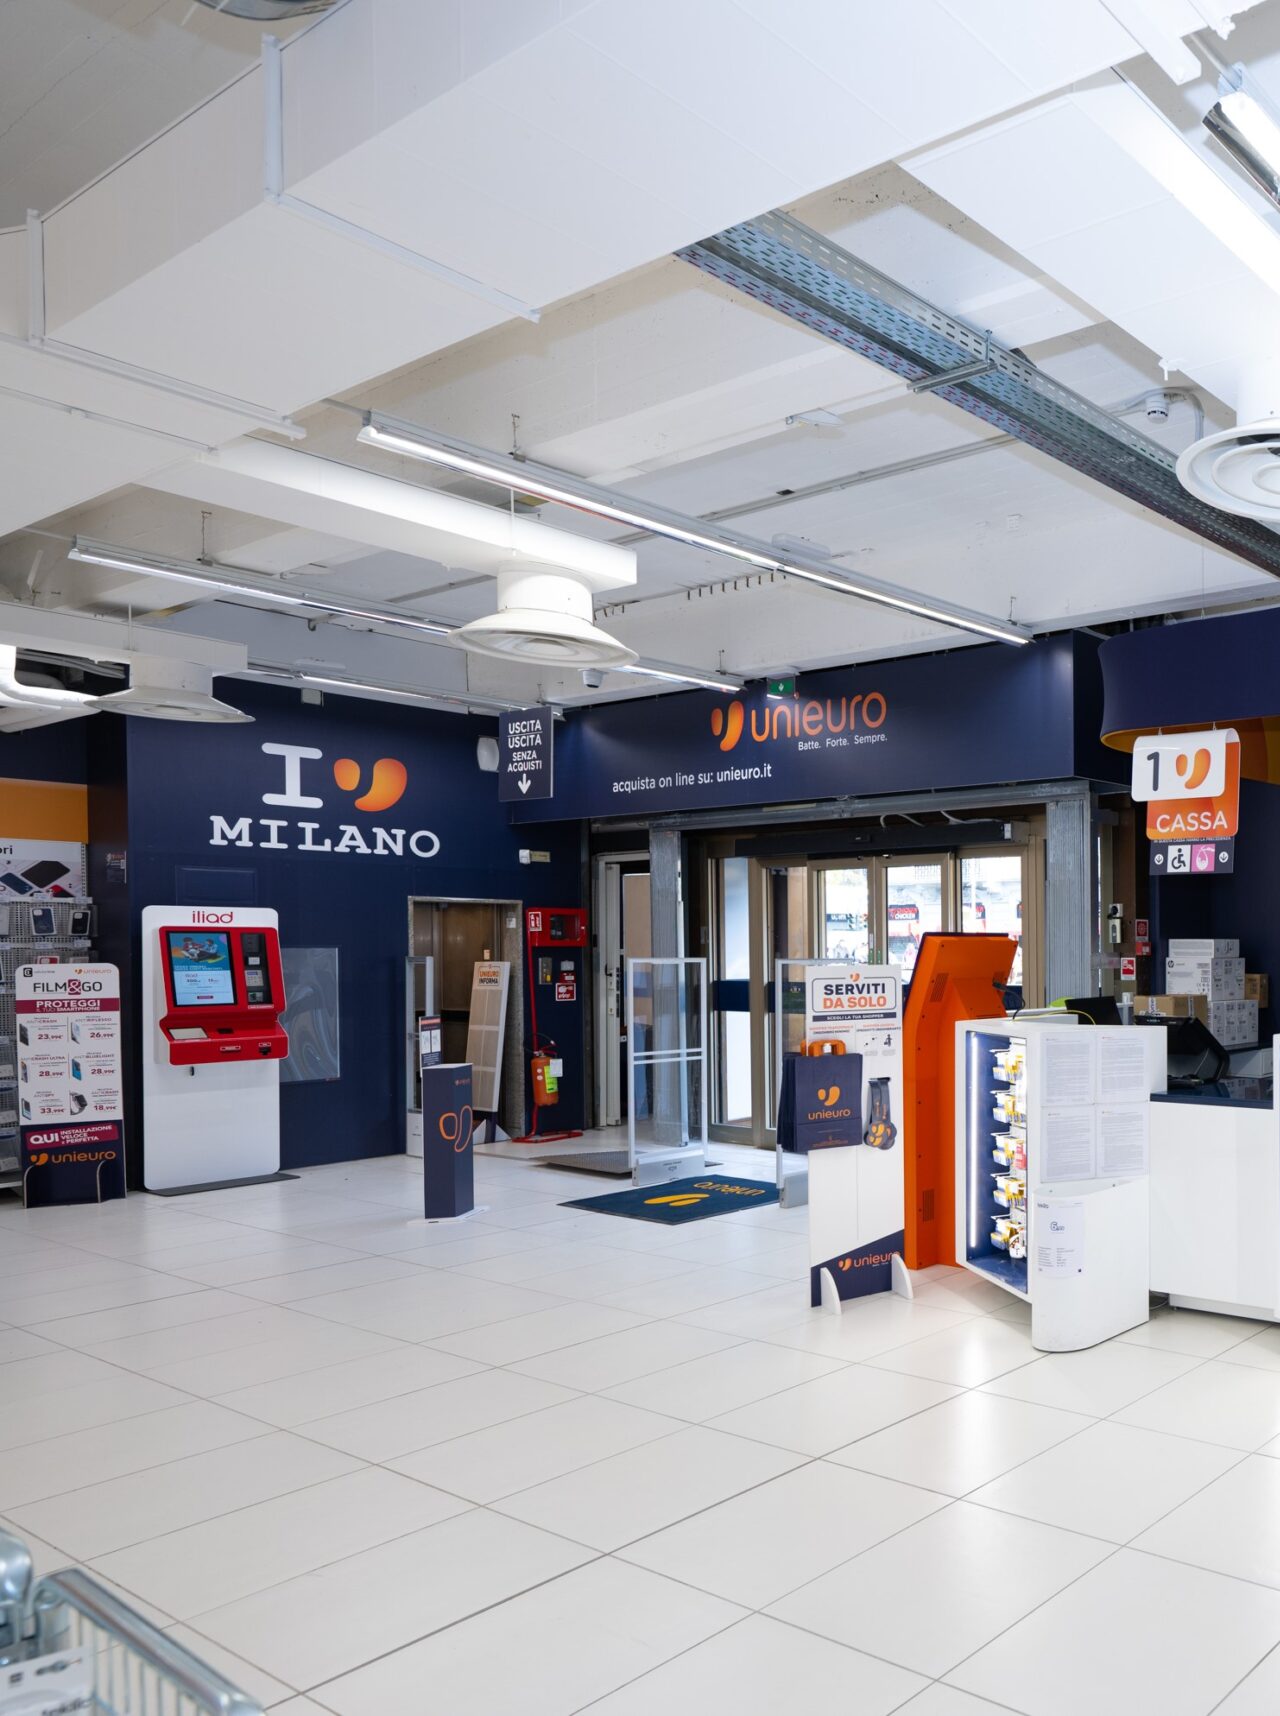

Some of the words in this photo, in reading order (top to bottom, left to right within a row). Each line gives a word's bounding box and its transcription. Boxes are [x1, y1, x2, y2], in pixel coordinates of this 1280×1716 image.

[751, 691, 887, 743] unieuro
[508, 719, 542, 735] USCITA
[507, 733, 543, 749] USCITA
[798, 740, 821, 751] Batte.
[826, 737, 849, 748] Forte.
[854, 733, 888, 747] Sempre.
[512, 750, 538, 762] SENZA
[507, 760, 543, 773] ACQUISTI
[1146, 751, 1160, 792] 1
[261, 742, 324, 809] I
[612, 776, 656, 793] acquista
[659, 777, 672, 788] on
[675, 772, 695, 786] line
[697, 773, 714, 784] su:
[716, 763, 772, 782] unieuro.it
[1156, 810, 1228, 833] CASSA
[209, 814, 441, 858] MILANO
[192, 911, 234, 924] iliad
[33, 979, 103, 995] FILM&GO
[478, 977, 499, 985] INFORMA
[824, 983, 886, 996] SERVITI
[36, 999, 101, 1008] PROTEGGI
[823, 997, 845, 1009] DA
[847, 995, 887, 1008] SOLO
[808, 1108, 851, 1120] unieuro
[60, 1124, 113, 1135] INSTALLAZIONE
[61, 1132, 88, 1140] VELOCE
[29, 1132, 60, 1145] QUI
[65, 1135, 99, 1144] PERFETTA
[51, 1150, 116, 1164] unieuro
[693, 1181, 766, 1196] unieuro
